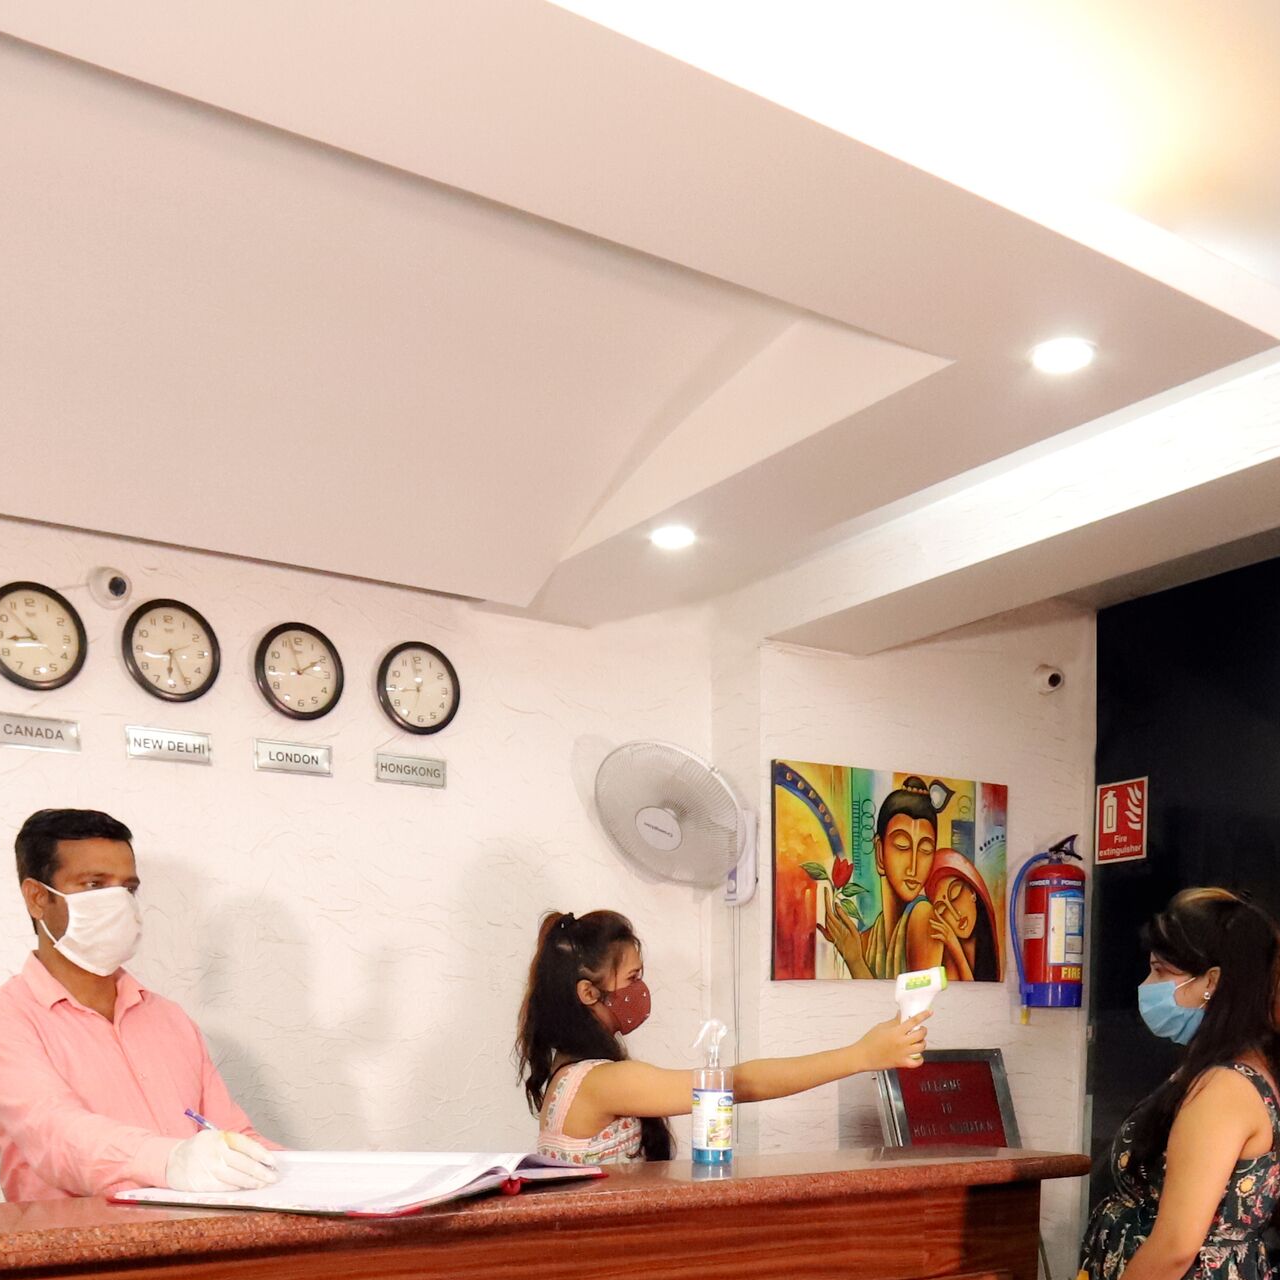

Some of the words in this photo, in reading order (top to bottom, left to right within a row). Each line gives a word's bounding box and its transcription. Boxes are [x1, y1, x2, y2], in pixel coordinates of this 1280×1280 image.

[24, 598, 35, 607] 12
[57, 617, 64, 626] 2
[163, 615, 173, 623] 12
[63, 635, 71, 643] 3
[192, 634, 199, 642] 2
[294, 637, 302, 645] 12
[2, 648, 10, 656] 8
[136, 645, 143, 653] 9
[60, 652, 68, 660] 4
[198, 651, 205, 659] 3
[320, 656, 326, 664] 2
[16, 661, 23, 670] 7
[49, 663, 57, 672] 5
[142, 662, 149, 670] 8
[33, 667, 41, 675] 6
[324, 671, 330, 679] 3
[154, 675, 160, 683] 7
[417, 715, 424, 723] 6
[3, 723, 64, 741] CANADA
[133, 737, 163, 751] NEW
[167, 740, 206, 755] DELHI
[268, 750, 319, 766] LONDON
[380, 763, 441, 779] HONGKONG
[1114, 834, 1128, 844] Fire
[1099, 844, 1142, 856] extinguisher
[1061, 966, 1081, 980] FIRE
